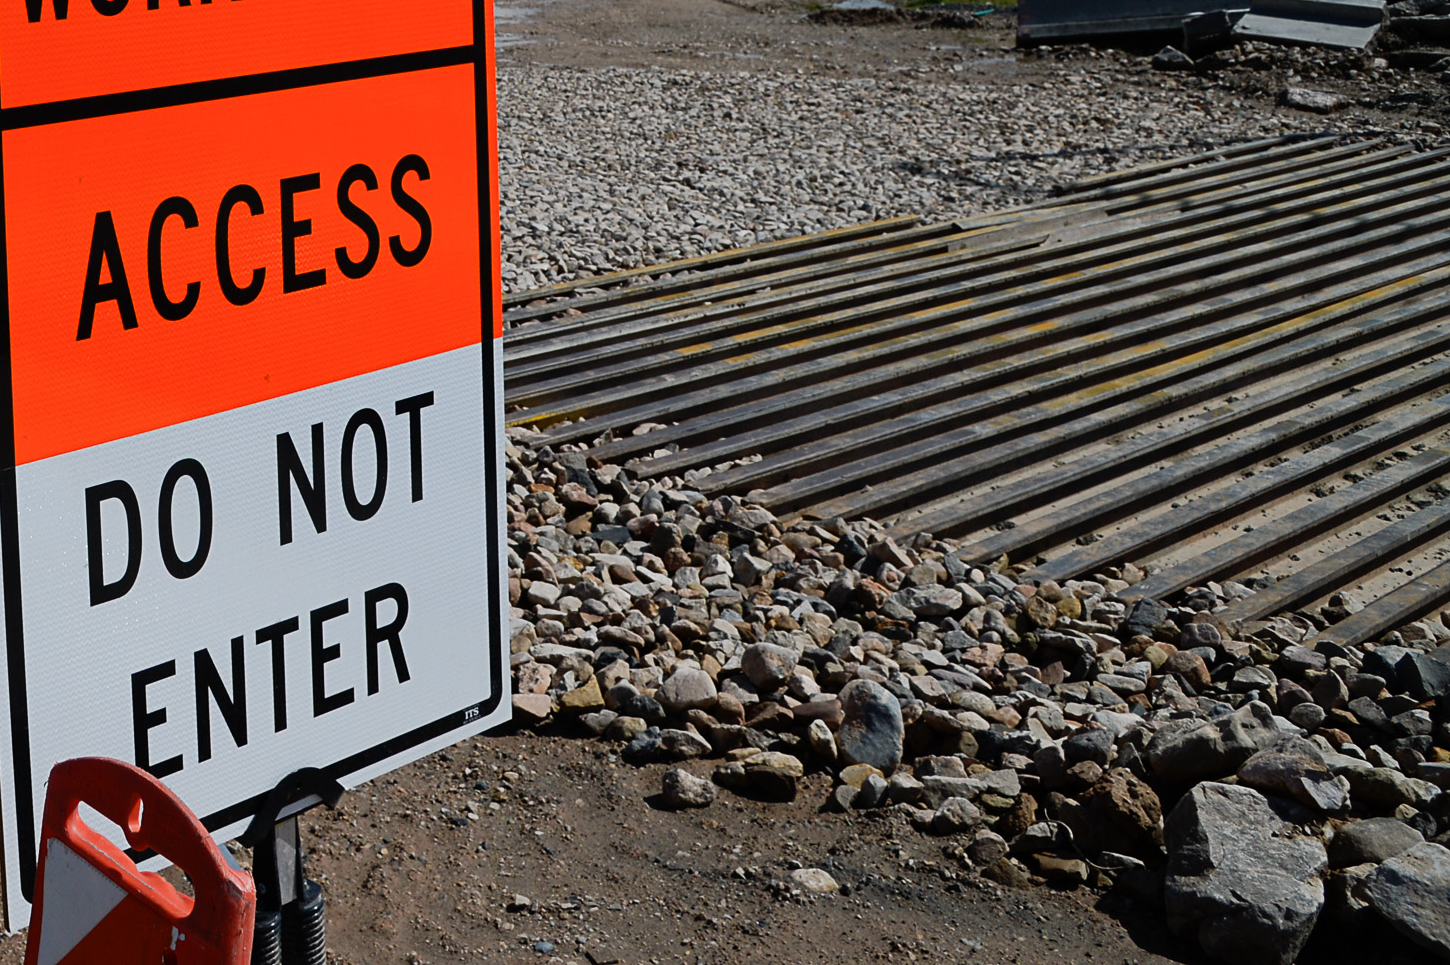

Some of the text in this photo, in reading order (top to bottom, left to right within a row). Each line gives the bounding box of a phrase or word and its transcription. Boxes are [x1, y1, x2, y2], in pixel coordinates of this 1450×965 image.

[75, 154, 433, 342] ACCESS
[84, 390, 436, 608] DO NOT
[130, 582, 411, 779] ENTER
[465, 707, 479, 720] ITS
